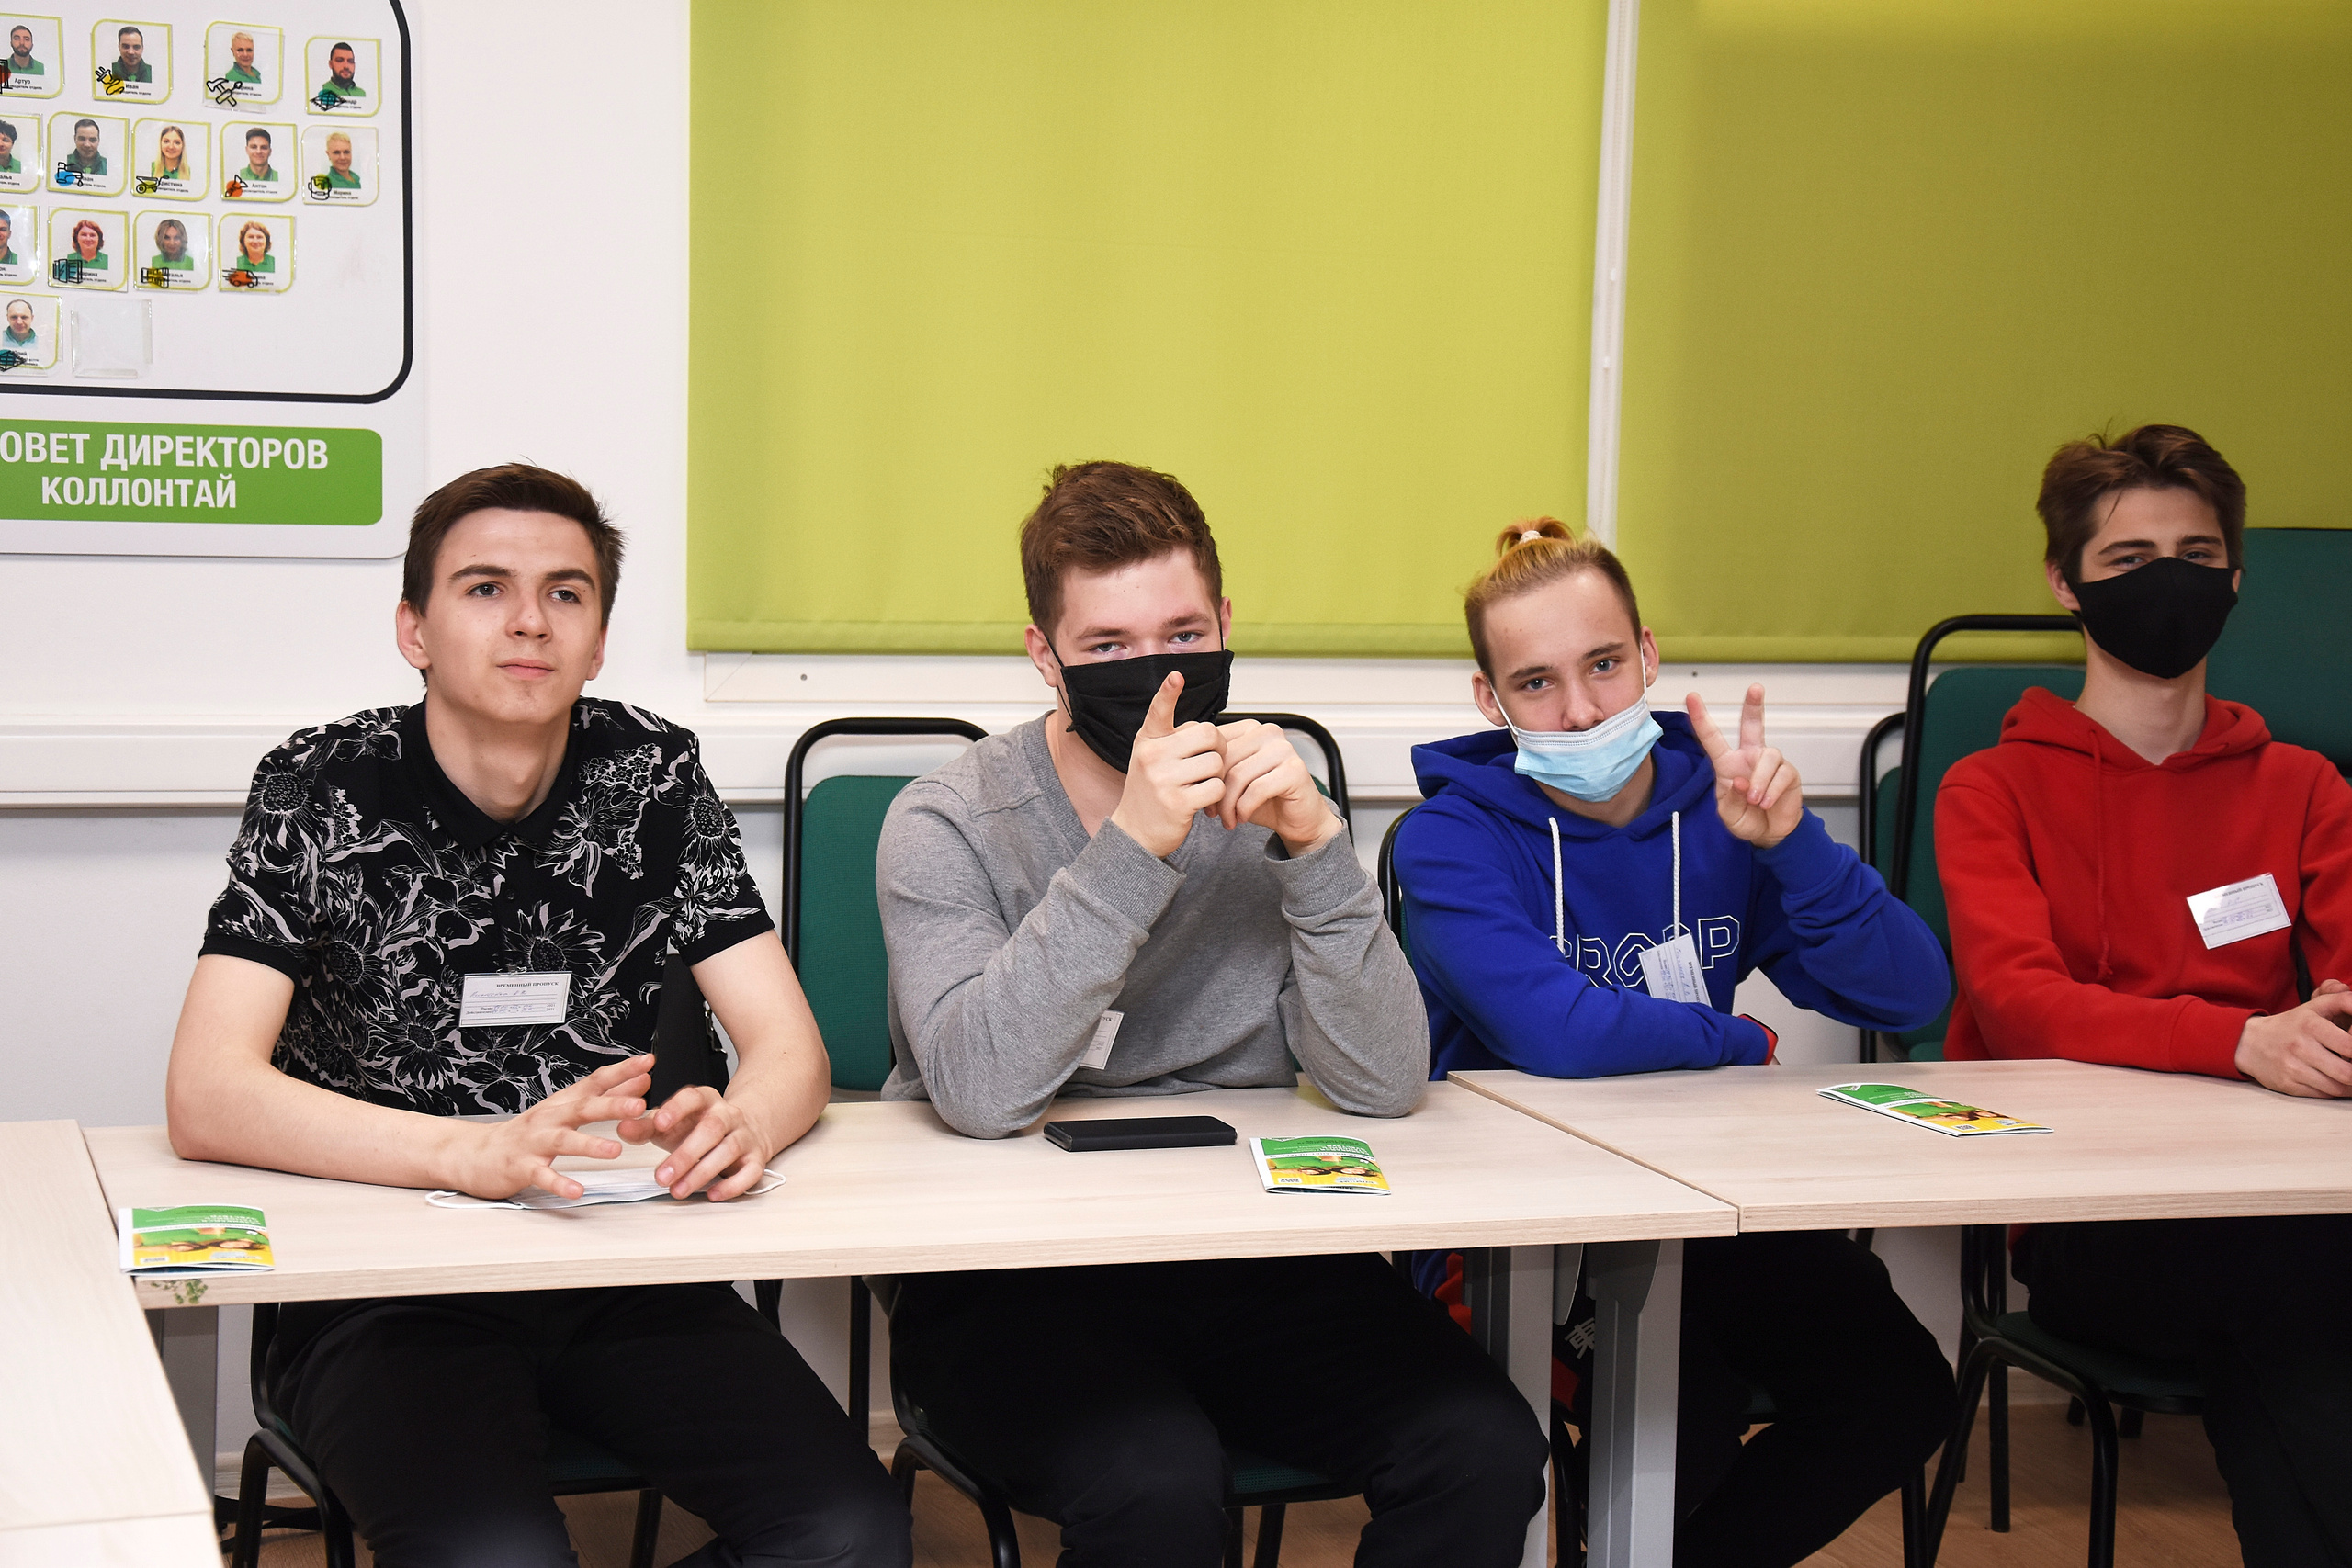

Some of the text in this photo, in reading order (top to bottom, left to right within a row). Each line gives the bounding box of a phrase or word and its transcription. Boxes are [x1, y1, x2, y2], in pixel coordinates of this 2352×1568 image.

[0, 430, 329, 471] ОВЕТ ДИРЕКТОРОВ
[41, 473, 237, 508] КОЛЛОНТАЙ
